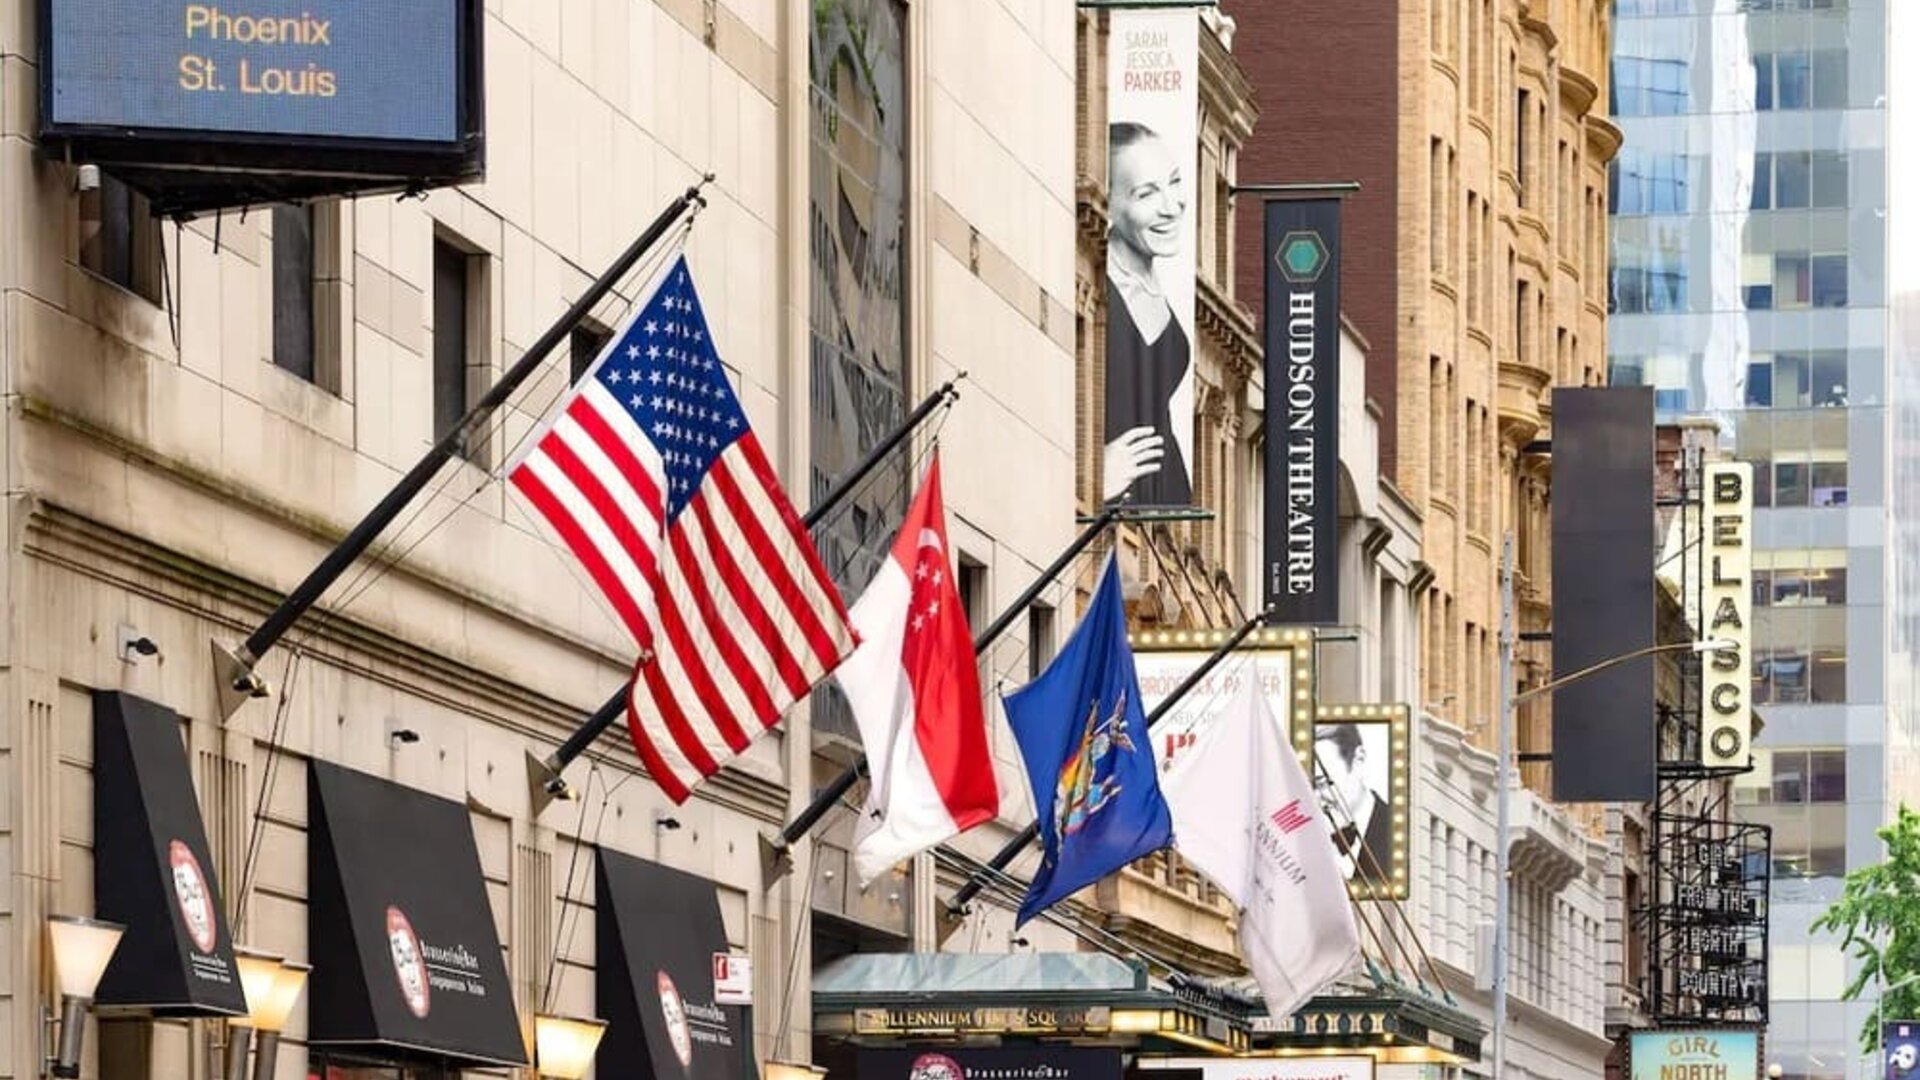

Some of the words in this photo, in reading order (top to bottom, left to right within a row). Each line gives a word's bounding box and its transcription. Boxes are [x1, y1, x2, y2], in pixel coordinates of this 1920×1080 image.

[186, 5, 330, 45] Phoenix
[1125, 31, 1168, 50] SARAH
[1125, 50, 1176, 70] JESSICA
[179, 54, 226, 92] St.
[240, 59, 337, 97] Louis
[1124, 70, 1182, 92] PARKER
[1288, 291, 1315, 432] HUDSON
[1288, 437, 1315, 595] THEATRE
[1710, 472, 1743, 760] BELASCO
[1722, 887, 1750, 914] THE
[1668, 1036, 1721, 1059] GIRL
[1660, 1063, 1727, 1080] NORTH
